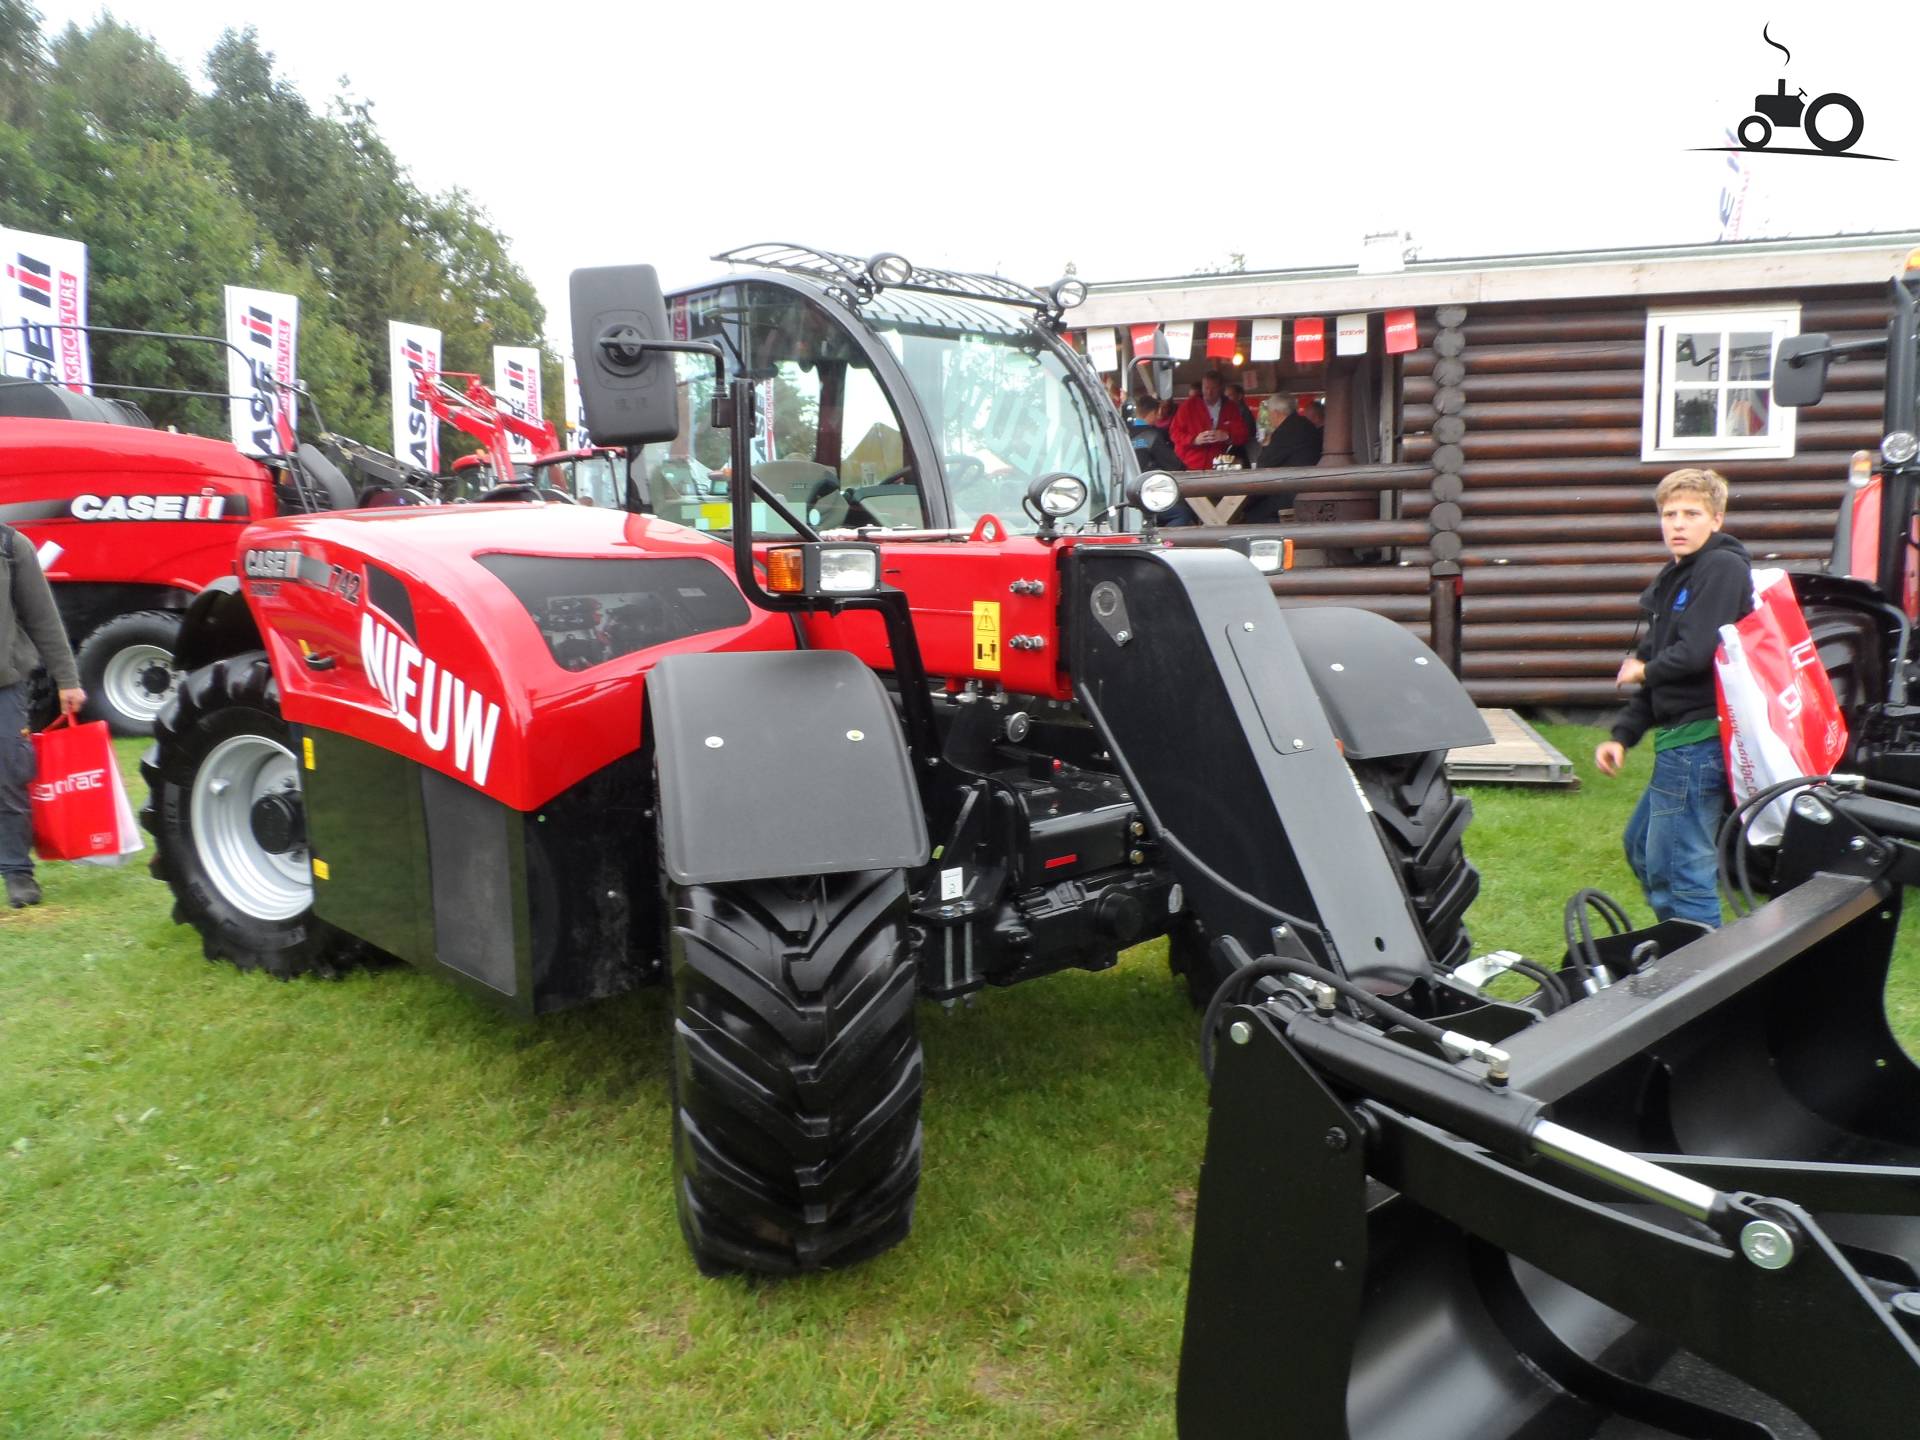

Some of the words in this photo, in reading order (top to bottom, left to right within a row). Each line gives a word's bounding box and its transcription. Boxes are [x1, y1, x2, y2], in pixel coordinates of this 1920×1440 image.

[1296, 333, 1323, 342] STEYR
[1339, 329, 1365, 337] STEYR
[1386, 323, 1414, 333] STEYR
[250, 358, 275, 456] ASE
[407, 382, 428, 469] ASE
[70, 494, 185, 521] CASE
[245, 549, 286, 579] CASE
[329, 562, 361, 606] 742
[360, 611, 501, 787] NIEUW
